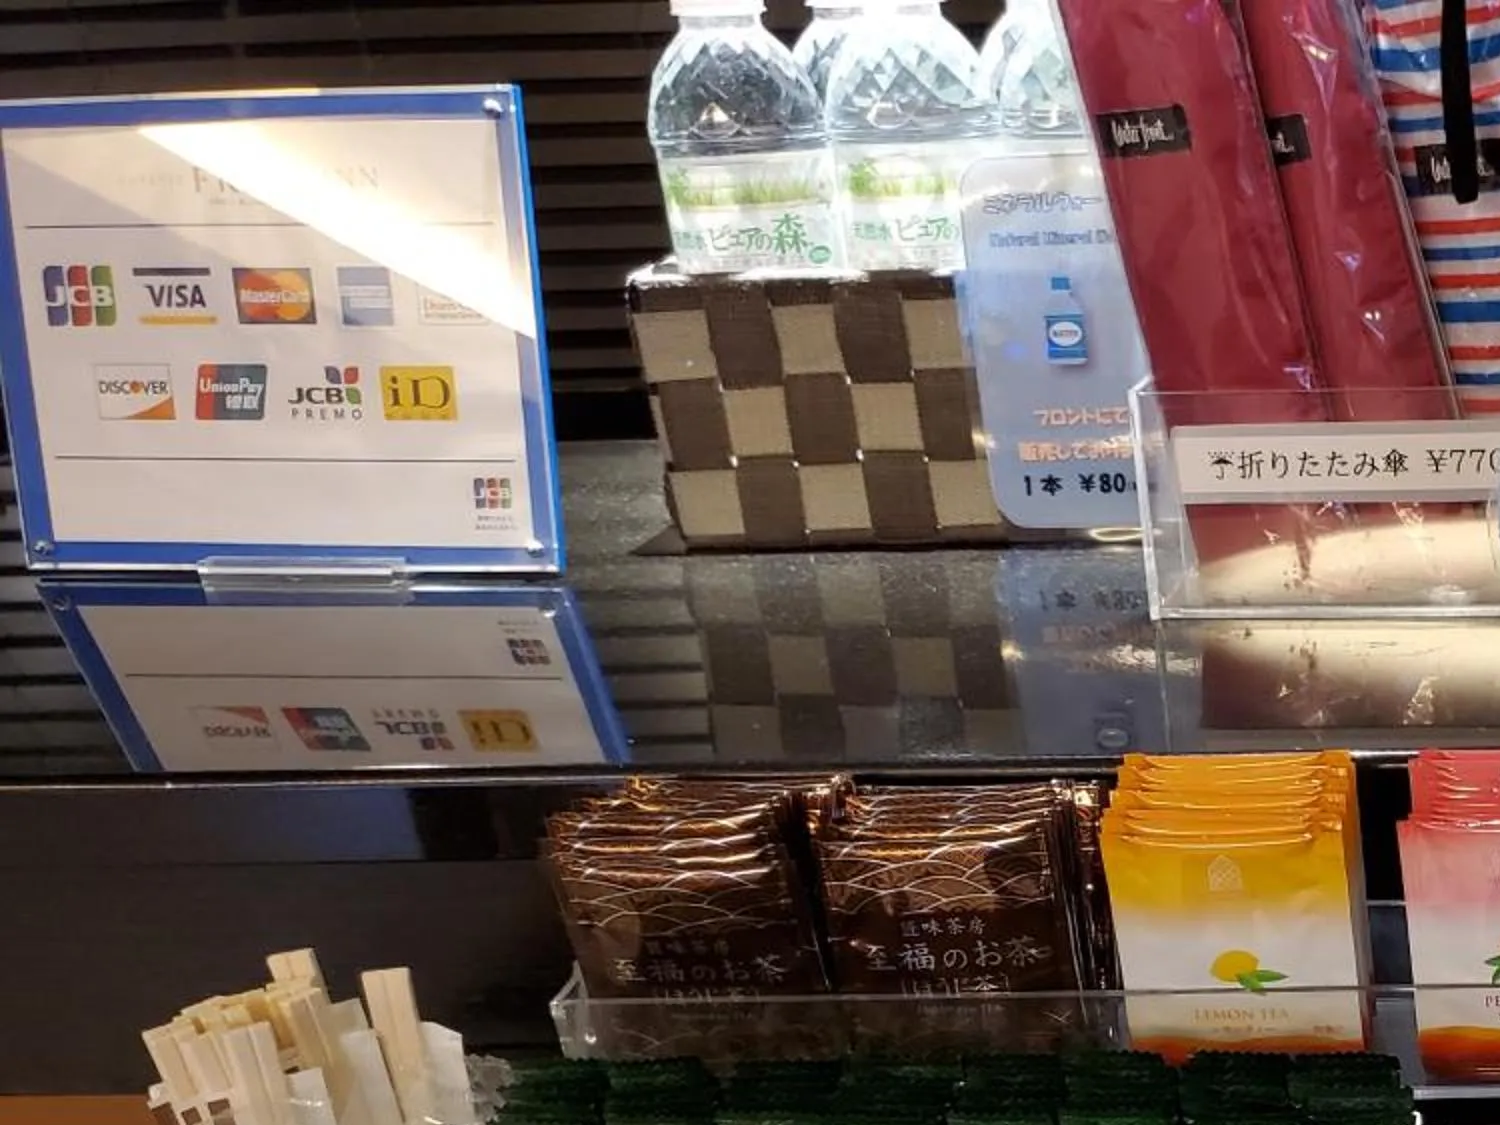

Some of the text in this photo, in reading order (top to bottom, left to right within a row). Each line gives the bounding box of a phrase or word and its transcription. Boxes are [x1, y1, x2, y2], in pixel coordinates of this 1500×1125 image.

[145, 285, 207, 309] VISA
[98, 374, 451, 409] DISCOVER UnionPay JCB iD
[291, 408, 363, 421] PREMO
